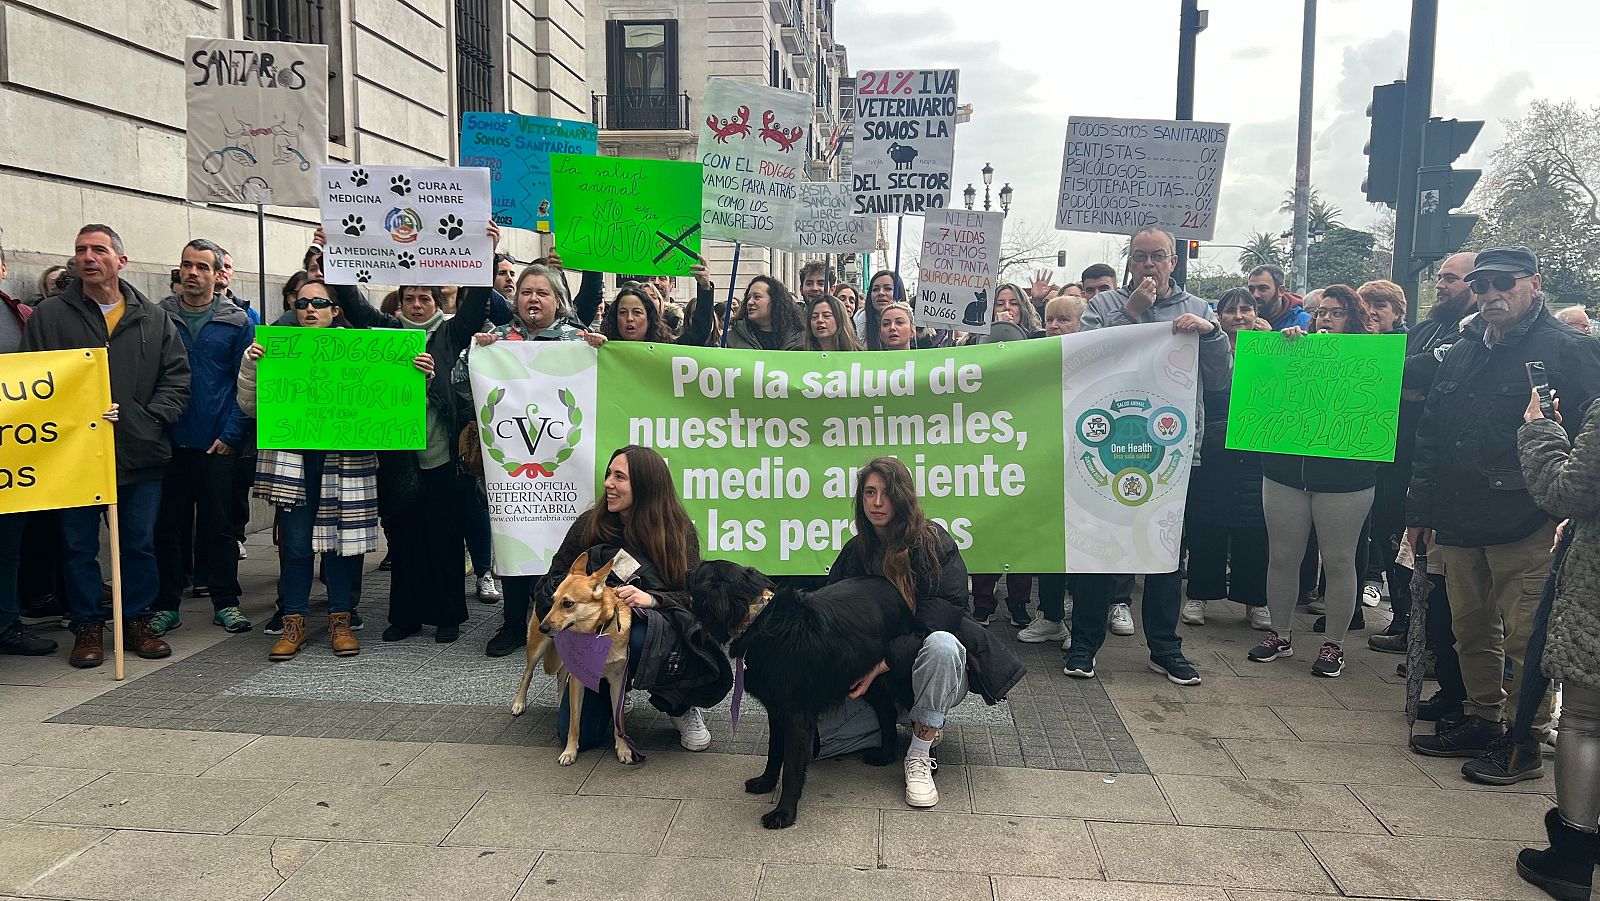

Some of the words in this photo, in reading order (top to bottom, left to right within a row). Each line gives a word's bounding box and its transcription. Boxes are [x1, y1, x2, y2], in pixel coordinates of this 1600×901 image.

[859, 71, 915, 95] 21%
[918, 70, 957, 95] IVA
[856, 97, 957, 117] VETERINARIO
[467, 115, 508, 132] SOMOS
[518, 115, 598, 141] VETERINARIOS
[862, 120, 920, 141] SOMOS
[925, 120, 949, 138] LA
[1068, 122, 1109, 137] TODOS
[1153, 125, 1226, 143] SANITARIOS
[474, 132, 511, 148] SOMOS
[1067, 141, 1147, 160] DENTISTAS
[554, 156, 581, 174] La
[596, 162, 648, 181] salud
[702, 152, 731, 169] CON
[736, 157, 754, 173] EL
[758, 160, 796, 180] RD/666
[919, 158, 937, 168] negra
[328, 181, 342, 189] LA
[417, 181, 447, 191] CURA
[449, 182, 462, 191] AL
[578, 181, 641, 197] animal
[702, 173, 740, 191] VAMOS
[741, 178, 766, 196] PARA
[768, 182, 797, 200] ATRÁS
[853, 174, 881, 192] DEL
[887, 172, 949, 190] SECTOR
[1063, 176, 1185, 198] FISIOTERAPEUTAS
[329, 194, 382, 204] MEDICINA
[418, 195, 464, 204] HOMBRE
[717, 194, 745, 212] COMO
[750, 200, 769, 213] LOS
[853, 193, 944, 215] SANITARIO
[592, 198, 624, 223] NO
[702, 209, 774, 231] CANGREJOS
[811, 208, 842, 220] LIBRE
[945, 211, 962, 227] NI
[966, 213, 984, 228] EN
[1059, 209, 1159, 227] VETERINARIOS
[795, 218, 865, 233] RESCRIPCIÓN
[560, 216, 652, 263] LUJO
[799, 232, 817, 246] NO
[821, 231, 858, 246] RD/666
[939, 228, 950, 241] 7
[954, 229, 985, 244] VIDAS
[329, 246, 342, 255] LA
[344, 247, 396, 256] MEDICINA
[418, 247, 447, 256] CURA
[458, 248, 471, 256] LA
[923, 241, 987, 260] PODREMOS
[329, 260, 397, 269] VETERINARIA
[419, 260, 483, 269] HUMANIDAD
[934, 257, 954, 271] CON
[959, 259, 990, 275] TANTA
[920, 268, 991, 289] BUROCRACIA
[922, 289, 937, 302] NO
[940, 292, 953, 304] AL
[924, 305, 957, 320] RD/666
[265, 334, 303, 359] EL
[1242, 336, 1340, 360] ANIMALES
[341, 366, 370, 382] UN
[671, 355, 742, 399] Por
[753, 361, 789, 399] la
[801, 361, 915, 400] salud
[928, 357, 982, 394] de
[0, 371, 55, 401] ud
[258, 378, 413, 410] SUPOSITORIO
[1247, 374, 1378, 414] MENOS
[268, 418, 327, 444] SIN
[330, 417, 424, 448] RECETA
[628, 408, 811, 449] nuestros
[822, 402, 1028, 451] animales,
[1234, 407, 1397, 458] PAPELOTES
[1110, 444, 1125, 453] One
[1127, 442, 1152, 453] Health
[487, 482, 532, 490] COLEGIO
[534, 482, 577, 490] OFICIAL
[683, 456, 810, 500] medio
[822, 454, 1026, 499] aiente
[488, 491, 577, 502] VETERINARIO
[489, 504, 501, 514] DE
[504, 504, 577, 514] CANTABRIA
[707, 508, 767, 553] las
